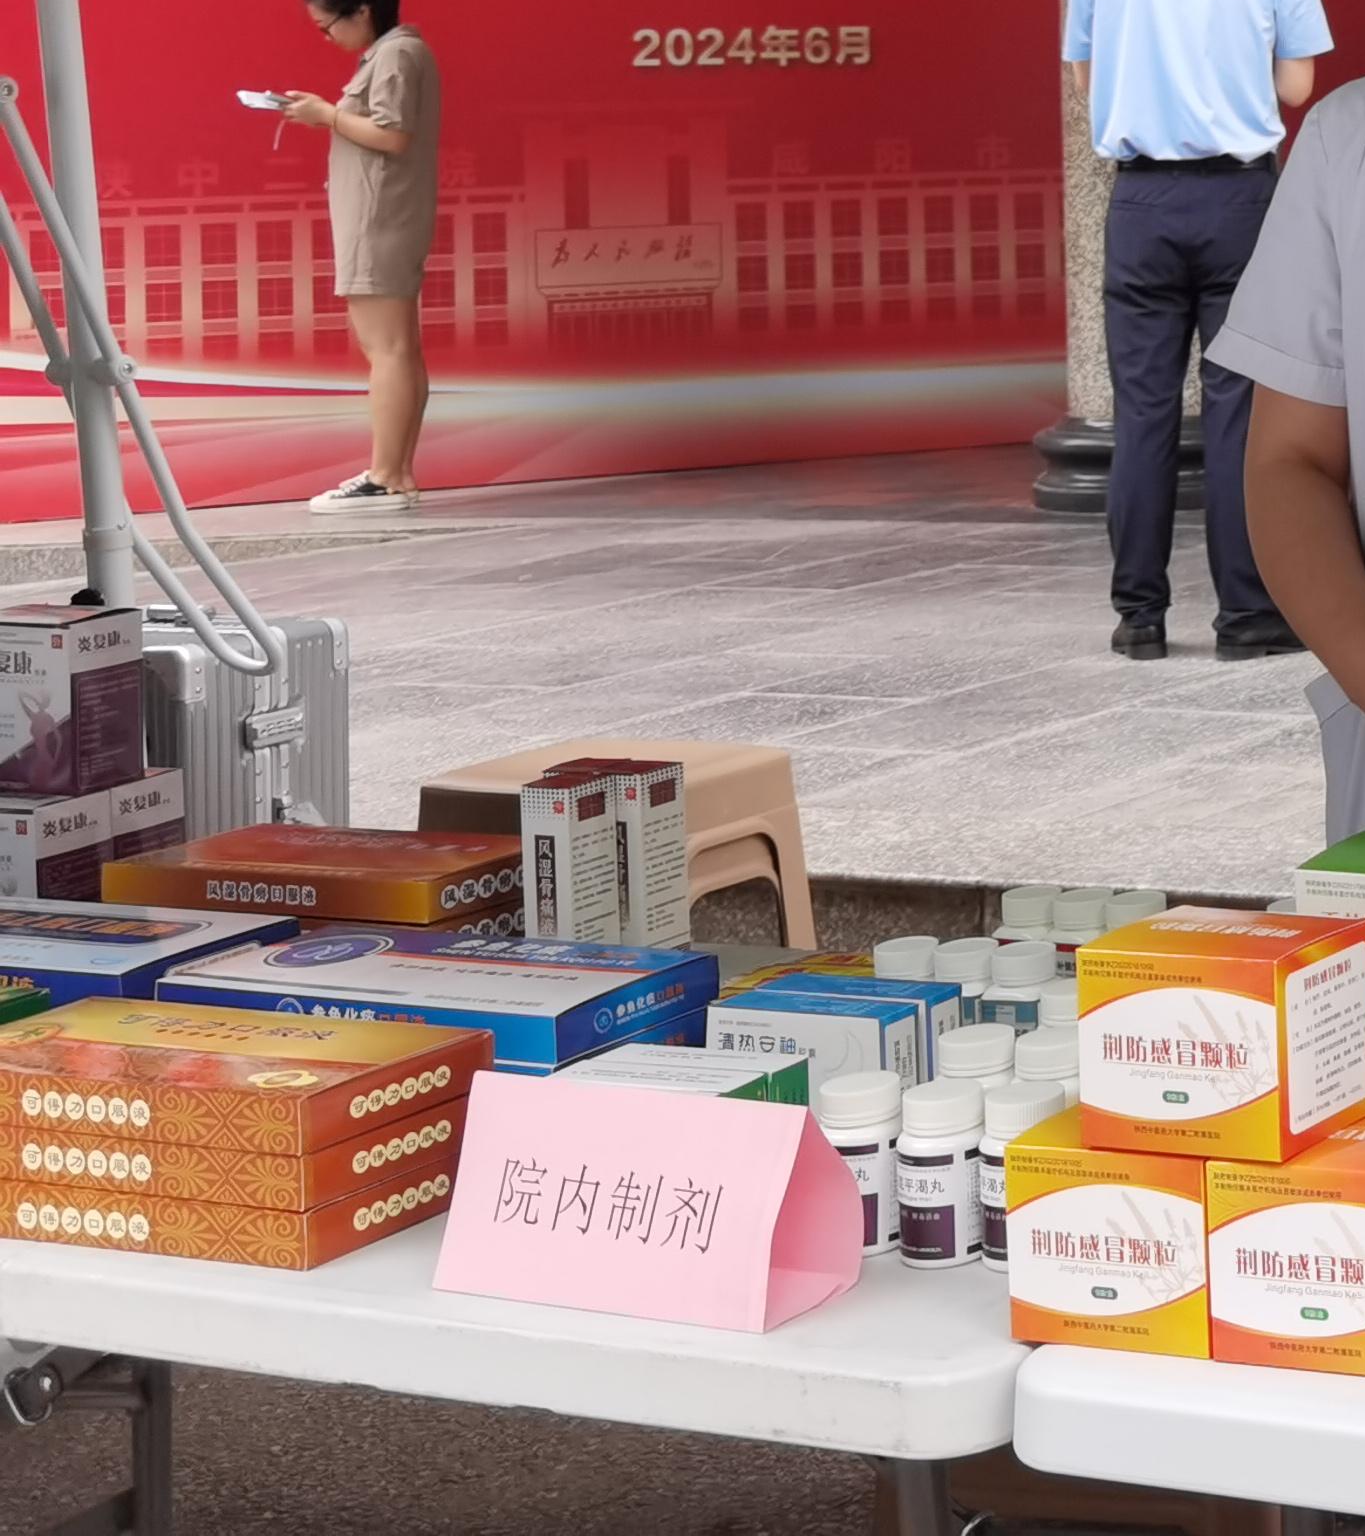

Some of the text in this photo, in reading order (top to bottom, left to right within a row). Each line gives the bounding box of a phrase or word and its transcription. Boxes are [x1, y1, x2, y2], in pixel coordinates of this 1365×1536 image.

[633, 25, 873, 67] 2024年6月
[1103, 1032, 1250, 1070] 荆防感冒颗粒
[493, 1156, 724, 1257] 院内制剂
[1031, 1227, 1177, 1266] 荆防感冒颗粒
